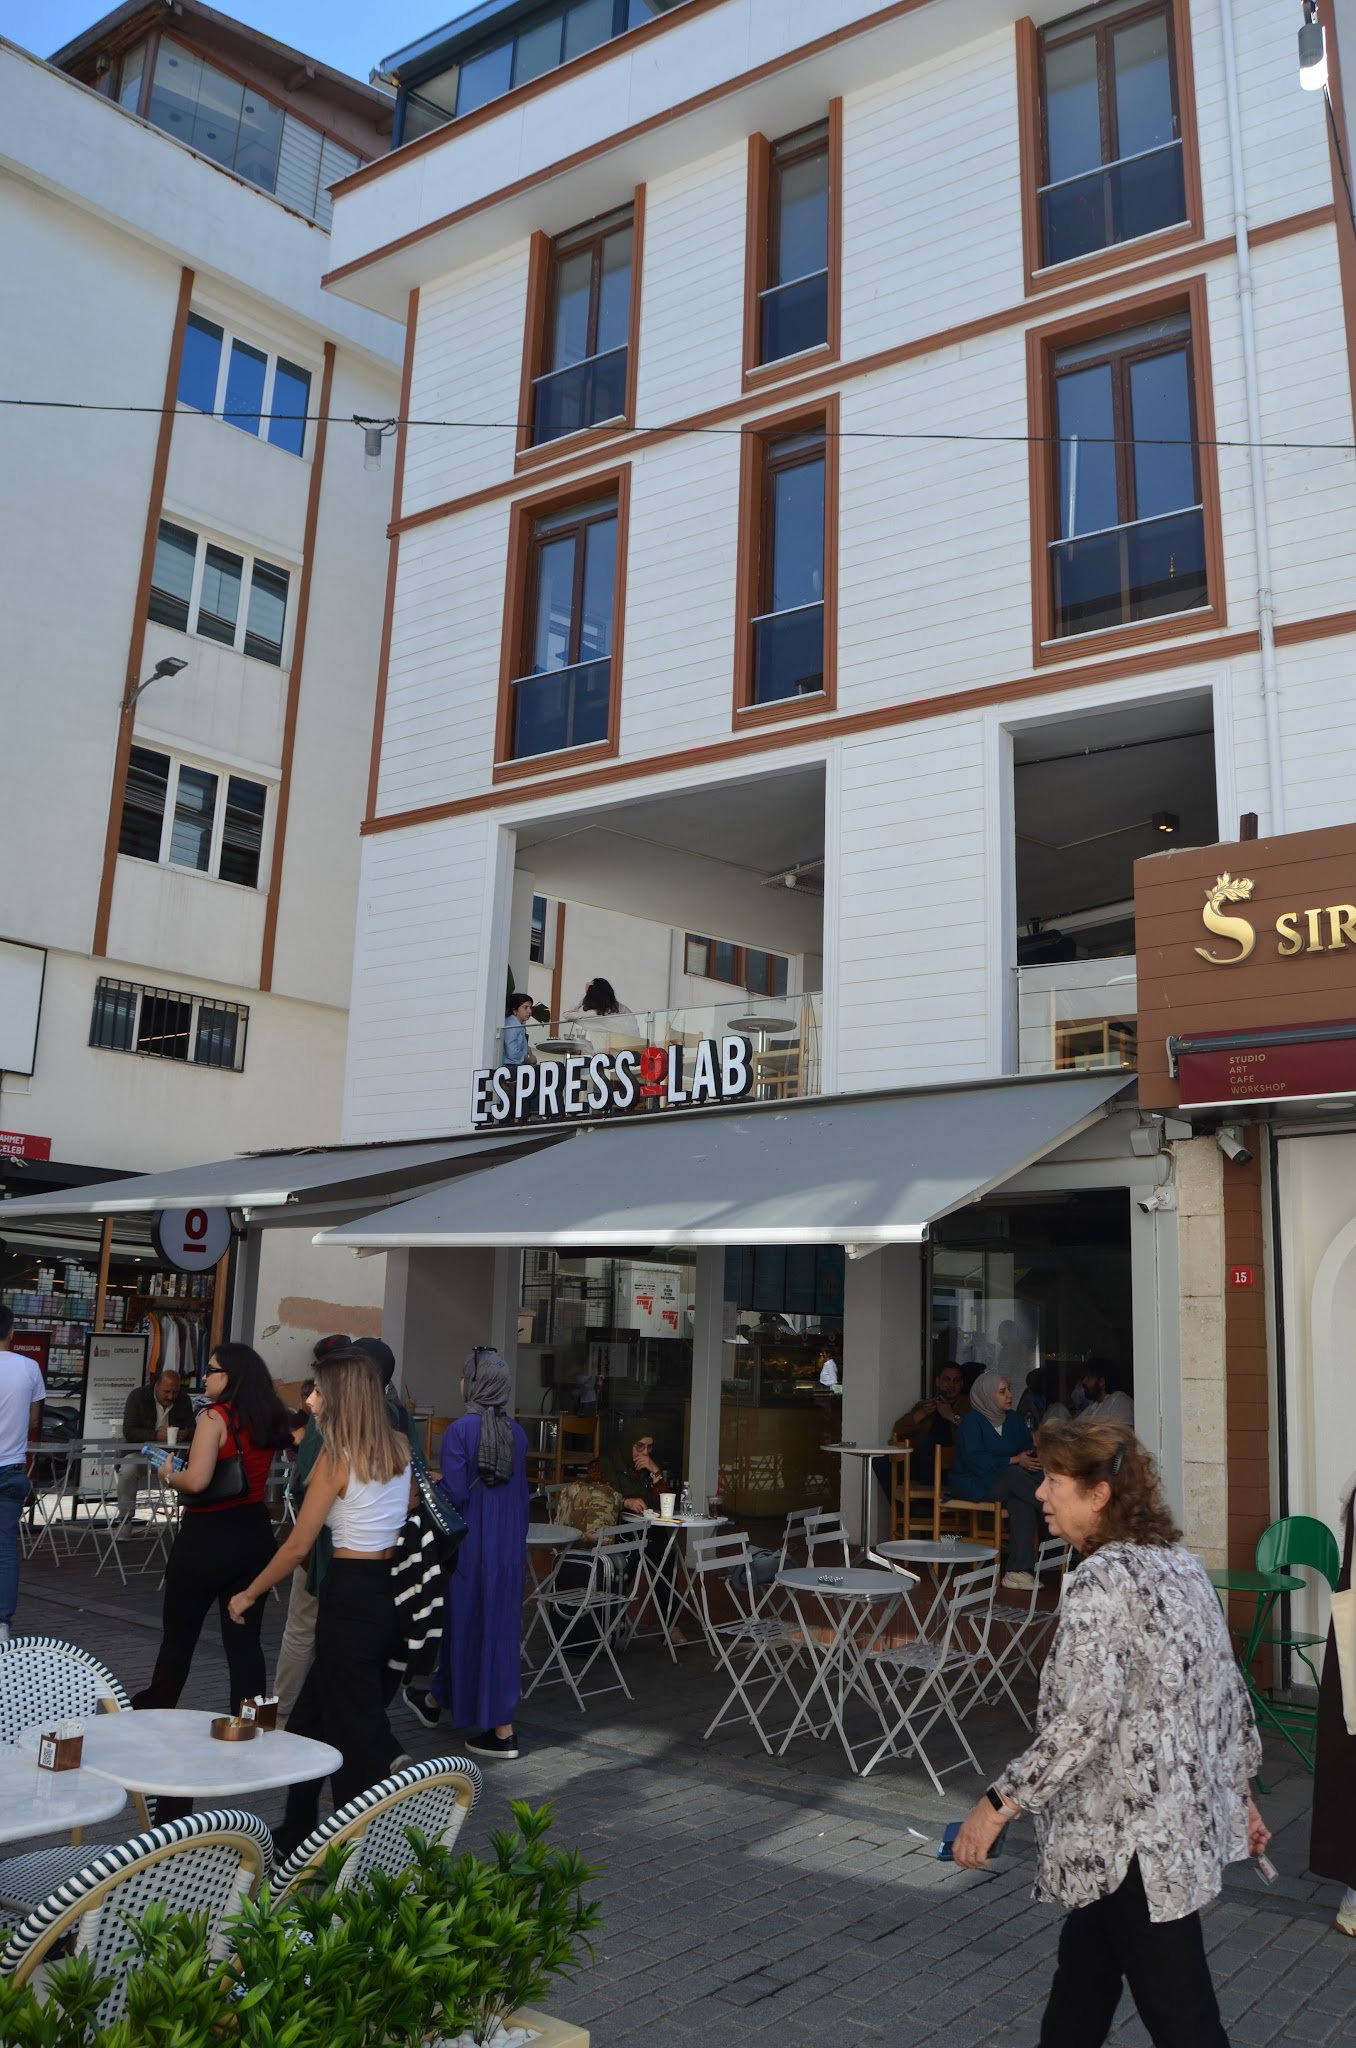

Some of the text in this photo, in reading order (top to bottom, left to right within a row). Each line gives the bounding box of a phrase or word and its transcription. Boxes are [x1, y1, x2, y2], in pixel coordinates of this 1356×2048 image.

[1275, 904, 1356, 956] SIR
[1229, 1054, 1266, 1064] STUDIO
[1229, 1065, 1248, 1074] ART
[471, 1035, 754, 1124] ESPRESSOLAB
[1230, 1075, 1255, 1084] CAFE
[1231, 1083, 1286, 1094] WORKSHOP
[1235, 1272, 1247, 1283] 15
